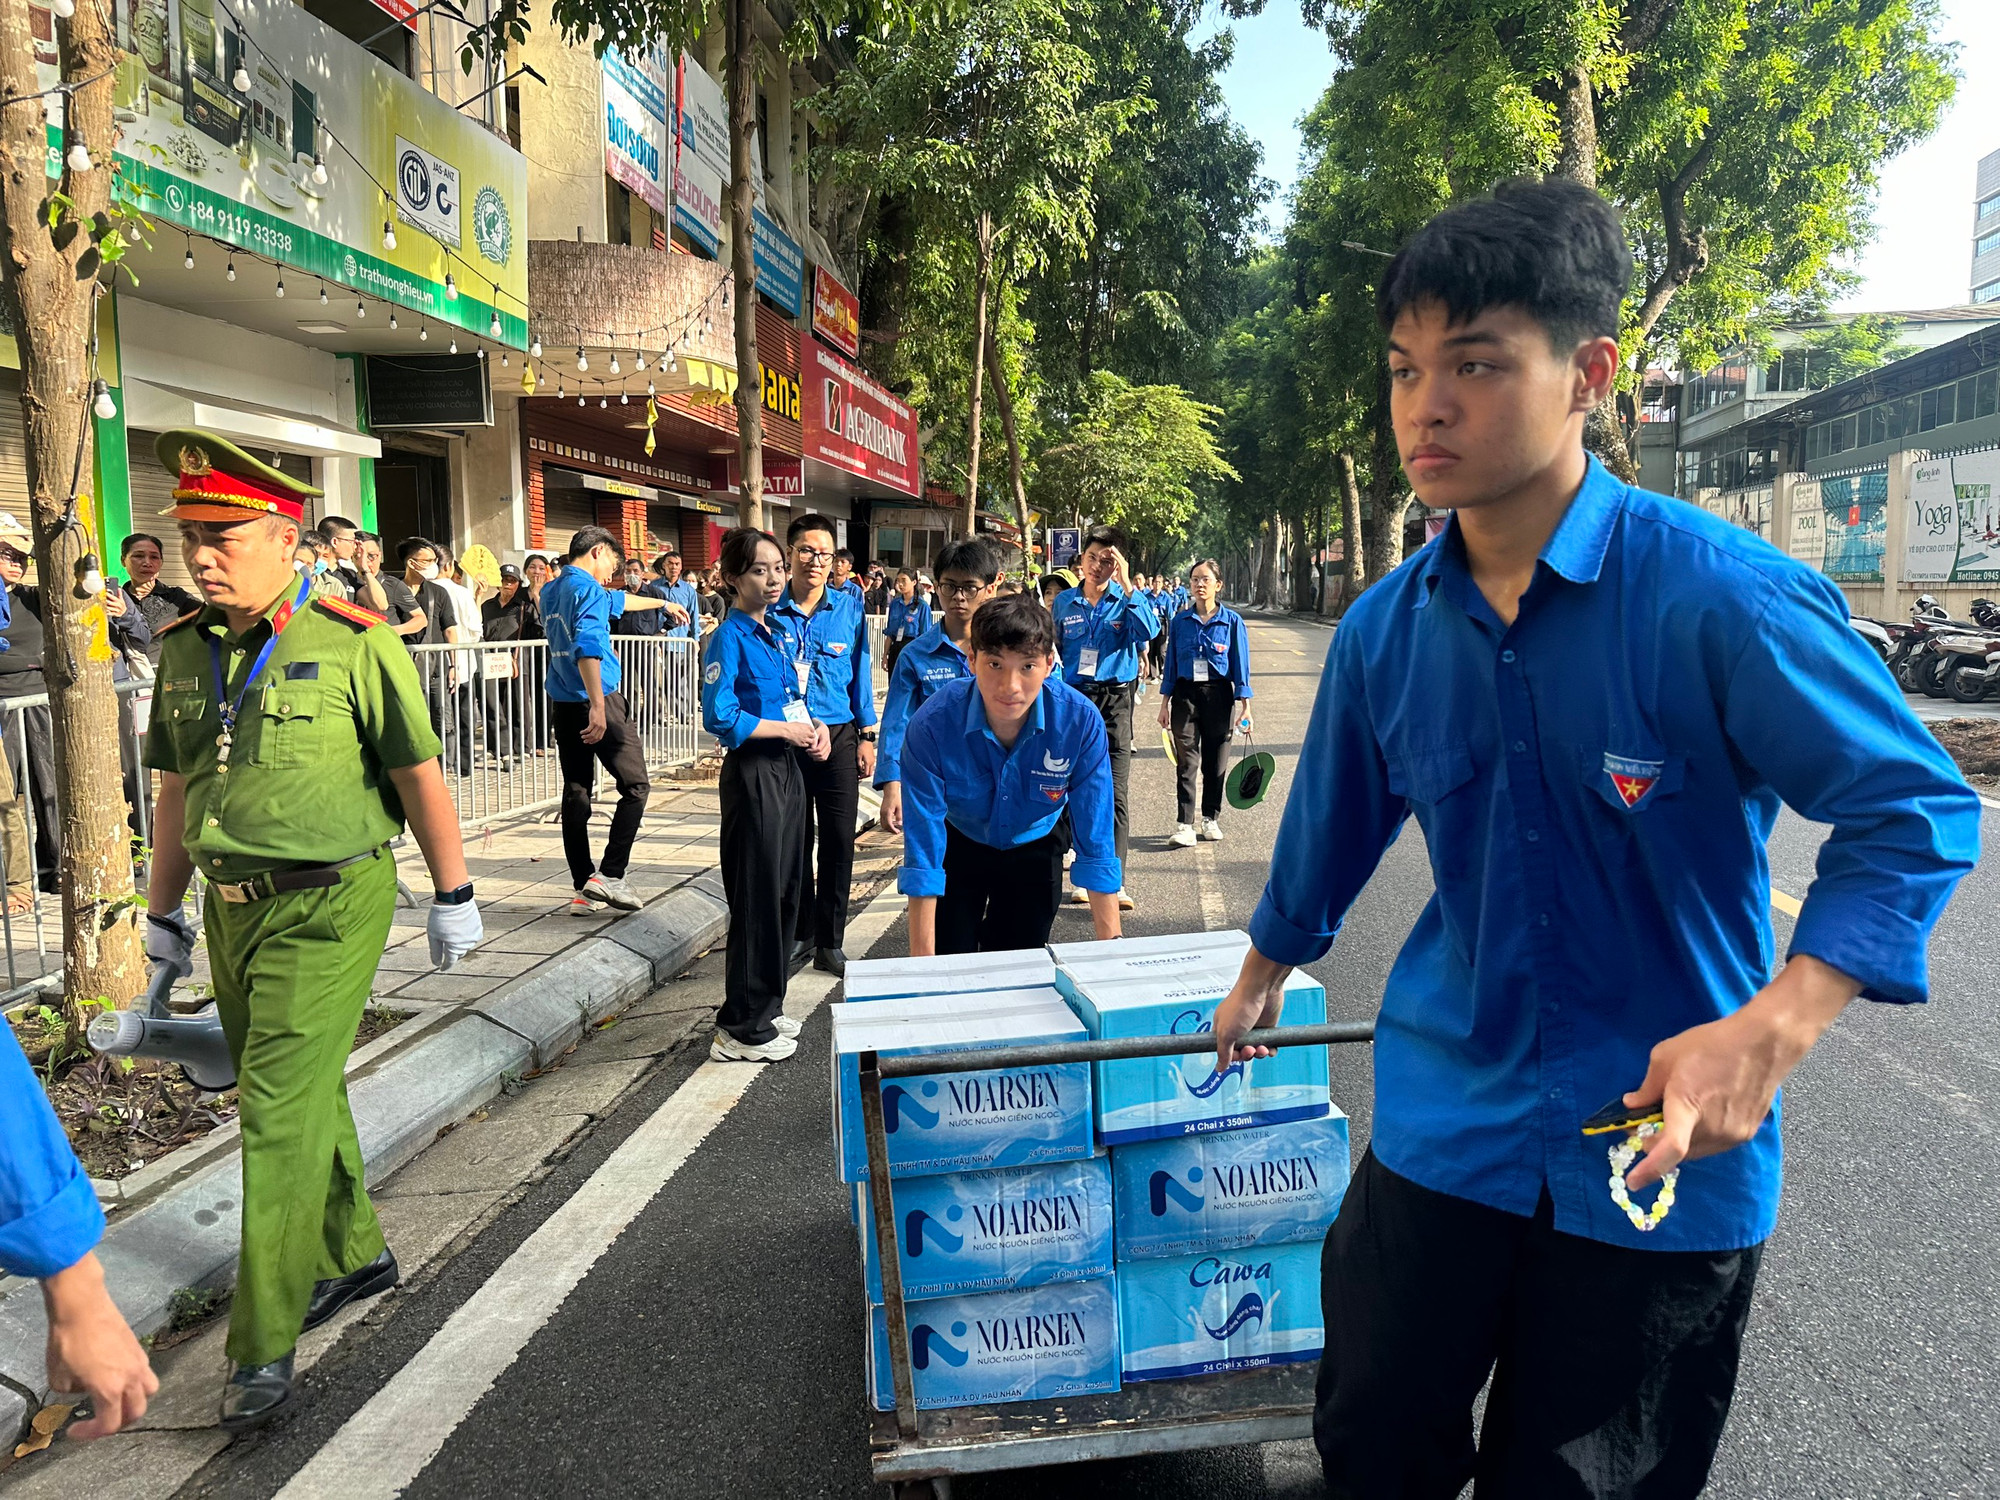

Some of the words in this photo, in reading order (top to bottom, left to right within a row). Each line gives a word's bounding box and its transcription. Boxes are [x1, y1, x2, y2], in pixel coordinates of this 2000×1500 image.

[433, 162, 455, 182] JAS-ANZ
[188, 200, 215, 221] +84
[217, 211, 250, 235] 9119
[253, 223, 292, 252] 33338
[359, 264, 434, 305] trathuonghieu.vn
[845, 403, 907, 467] AGRIBANK
[605, 480, 639, 498] Exclusive
[763, 476, 799, 492] ATM
[696, 500, 722, 514] Exclusive
[1798, 515, 1816, 530] POOL
[1915, 499, 1952, 536] Yoga
[1926, 544, 1937, 553] CHO
[1957, 572, 1982, 580] Hotline:
[1984, 571, 1999, 580] 0945
[490, 664, 507, 673] STOP
[927, 667, 952, 675] SVTN
[948, 1071, 1060, 1116] NOARSEN
[1185, 1124, 1196, 1133] 24
[1197, 1121, 1217, 1131] Chai
[1226, 1116, 1252, 1127] 350ml
[1200, 1133, 1242, 1144] DRINKING
[1242, 1130, 1270, 1140] WATER
[1029, 1148, 1038, 1157] 24
[1039, 1147, 1058, 1156] Chai
[857, 1166, 870, 1175] CÔ
[895, 1161, 918, 1171] TNHH
[920, 1160, 931, 1169] TM
[941, 1158, 951, 1167] DV
[960, 1170, 1003, 1182] DRINKING
[1003, 1167, 1032, 1178] WATER
[1212, 1155, 1318, 1200] NOARSEN
[973, 1193, 1081, 1240] NOARSEN
[1163, 1242, 1184, 1251] TNHH
[1189, 1257, 1272, 1288] Cawa
[976, 1311, 1085, 1354] NOARSEN
[1203, 1364, 1213, 1372] 24
[1216, 1361, 1235, 1371] Chai
[1244, 1357, 1270, 1367] 350ml
[1056, 1384, 1065, 1392] 24
[926, 1396, 947, 1405] TNHH
[949, 1395, 960, 1403] TM
